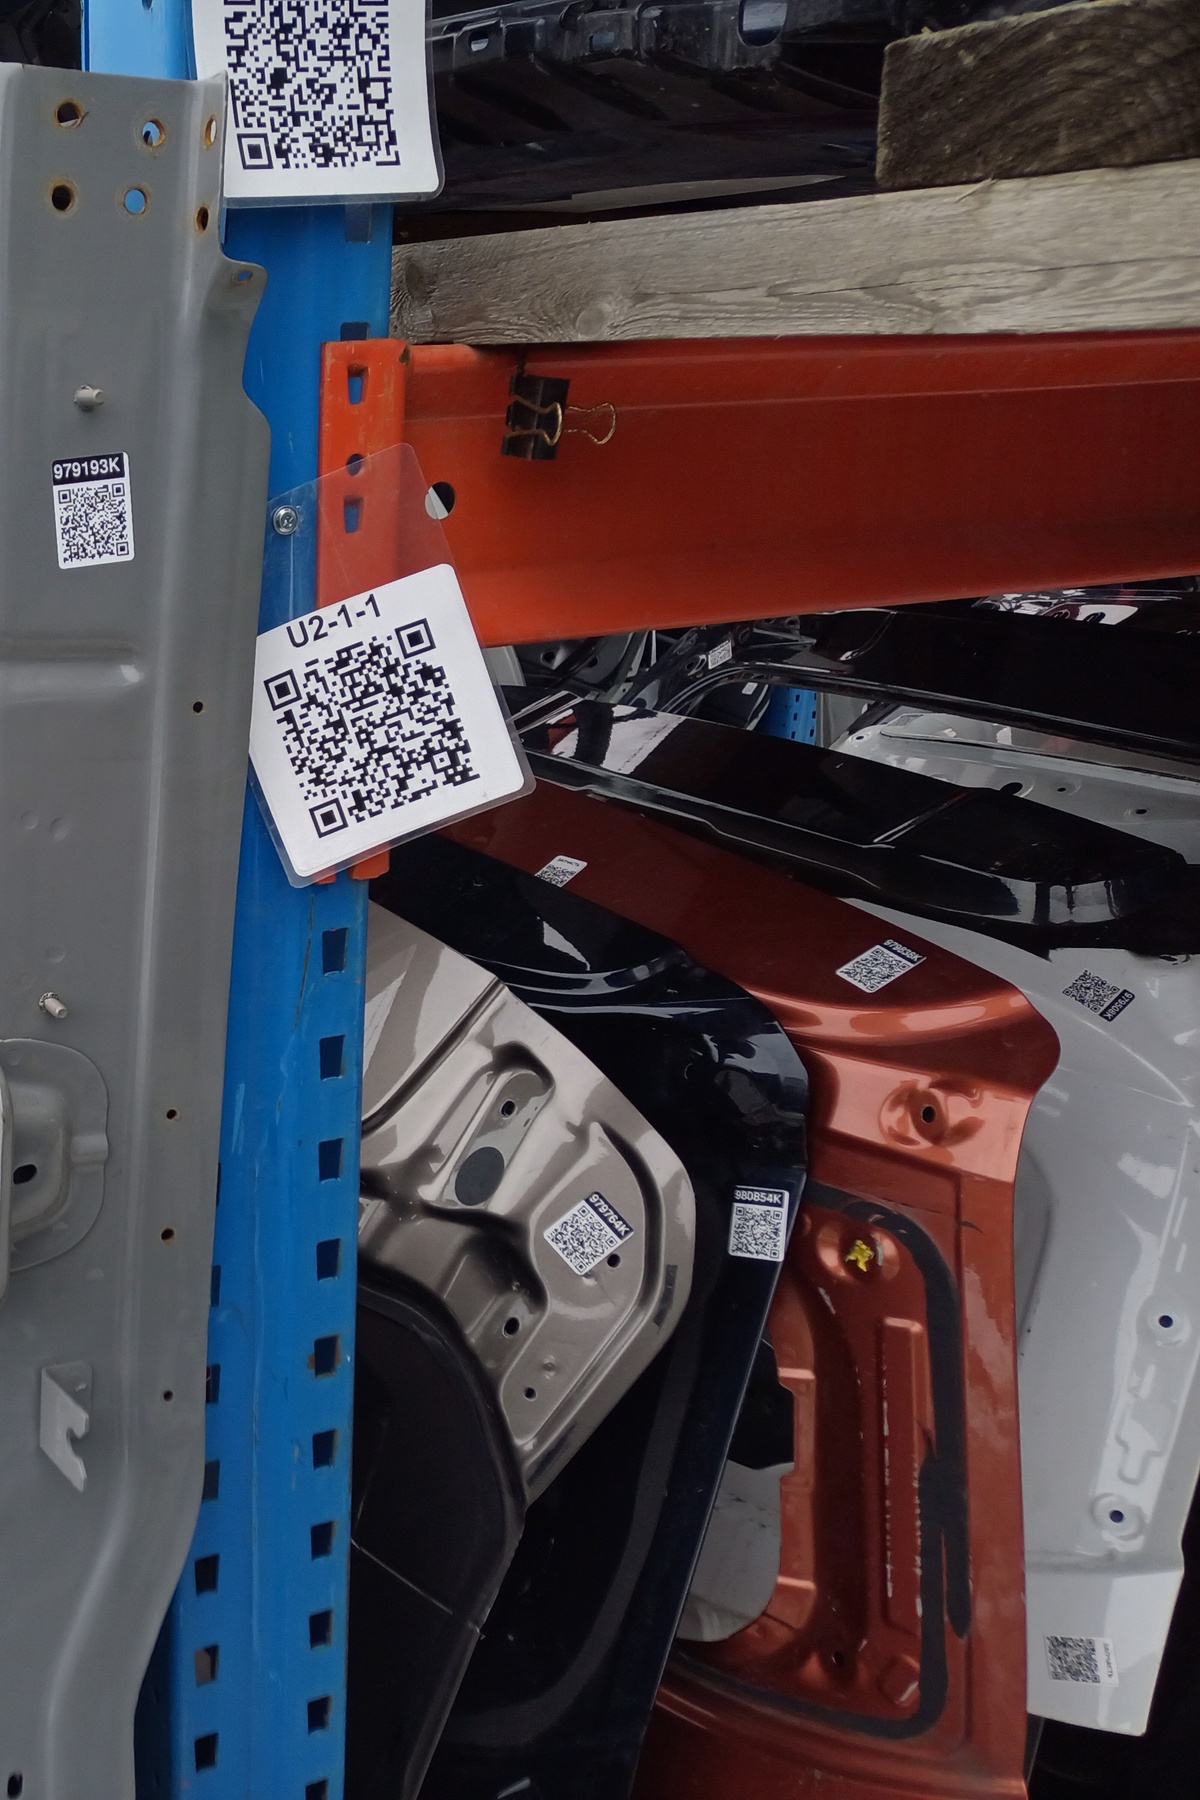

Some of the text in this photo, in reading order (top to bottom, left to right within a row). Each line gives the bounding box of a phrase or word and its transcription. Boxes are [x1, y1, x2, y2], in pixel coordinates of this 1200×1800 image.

[53, 456, 121, 479] 979193K
[286, 593, 381, 648] U2-1-1
[1103, 992, 1133, 1020] 979508K
[734, 1190, 782, 1205] 980854K
[589, 1194, 630, 1237] 979764K
